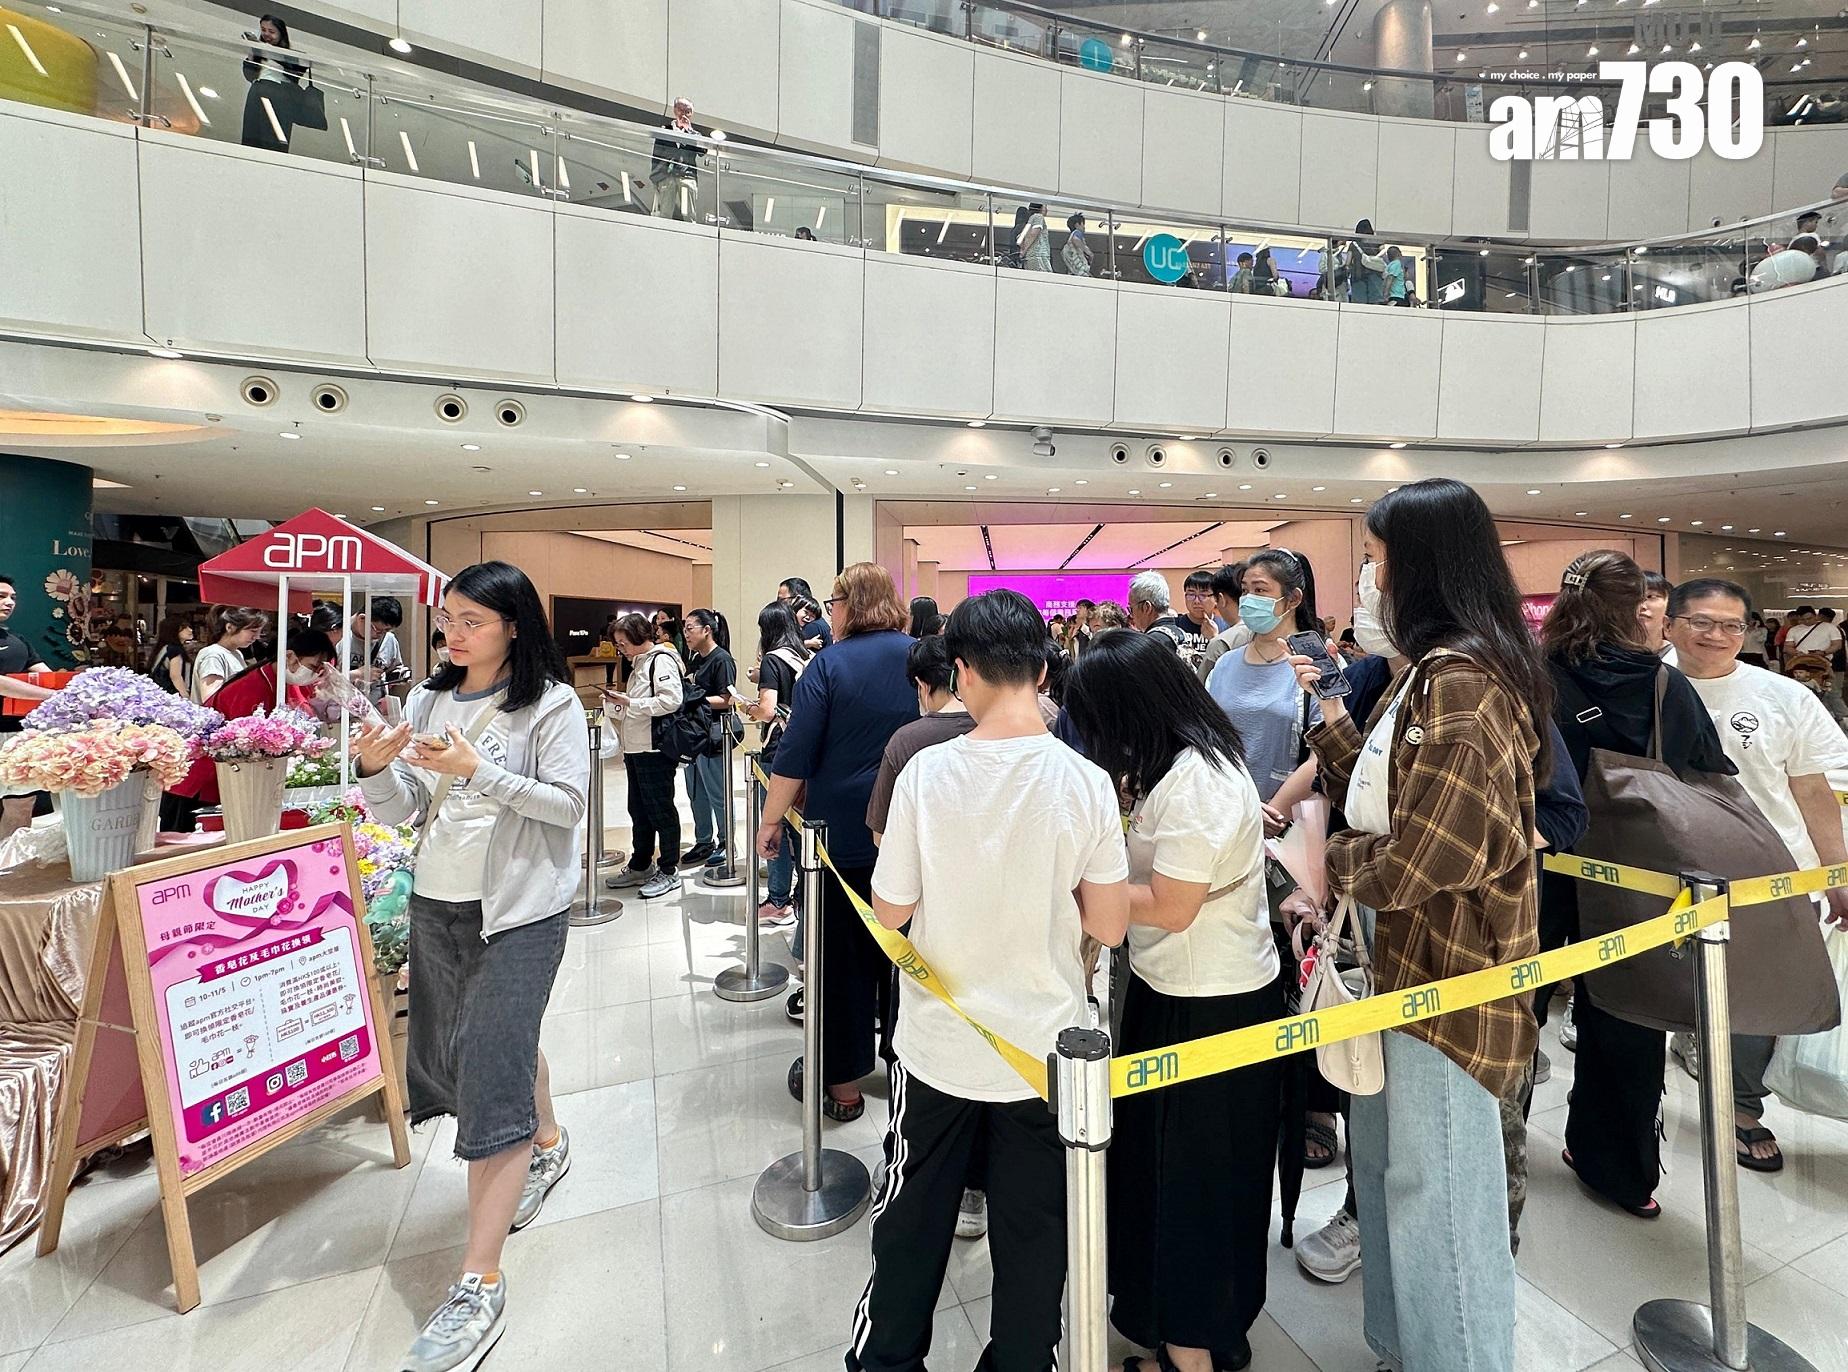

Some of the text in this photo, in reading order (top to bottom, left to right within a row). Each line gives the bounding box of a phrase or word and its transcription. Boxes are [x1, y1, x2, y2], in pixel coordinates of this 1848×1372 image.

[264, 532, 363, 571] apm
[1580, 861, 1620, 883] apm
[1770, 866, 1848, 897] apm apm
[152, 884, 191, 905] apm
[226, 886, 284, 910] Mother's
[242, 882, 270, 894] HAPPY
[252, 904, 269, 913] DAY
[160, 921, 216, 941] 母親節限定
[214, 934, 312, 975] 香皂花及毛巾花換領
[254, 967, 285, 981] 1pm-7pm
[199, 987, 226, 1001] 10-11/5
[1127, 909, 1698, 1089] apm apm apm apm apm apm
[211, 1047, 231, 1062] apm
